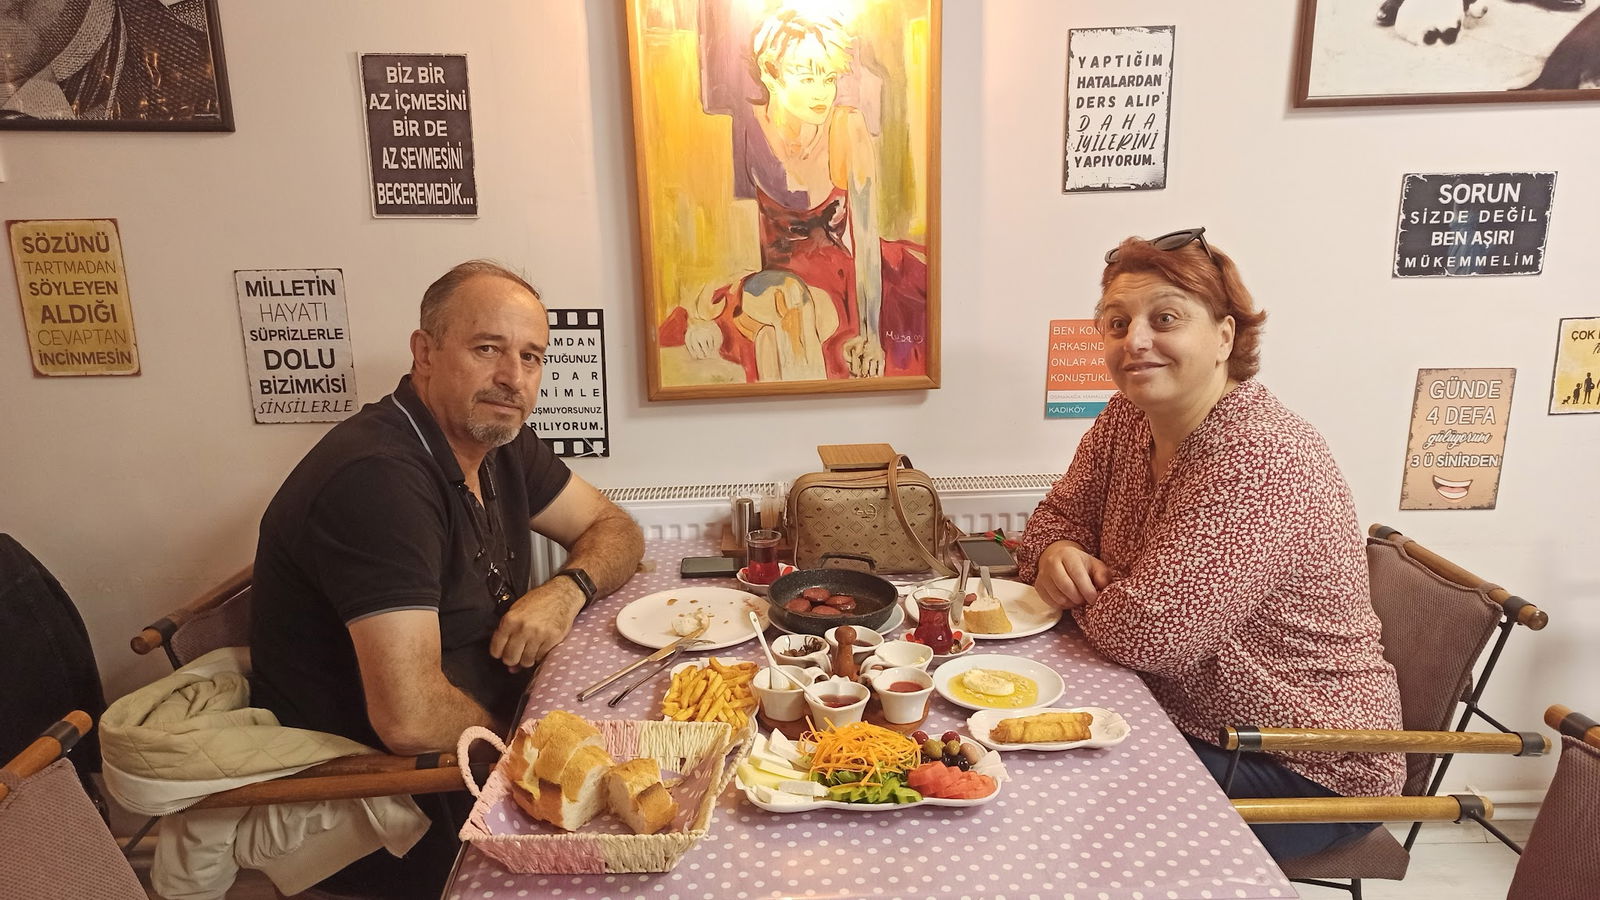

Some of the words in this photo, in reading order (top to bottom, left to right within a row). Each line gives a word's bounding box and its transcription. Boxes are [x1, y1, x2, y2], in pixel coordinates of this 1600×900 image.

[1078, 51, 1163, 68] YAPTIĞIM
[386, 62, 414, 84] BİZ
[418, 62, 445, 84] BİR
[1077, 74, 1162, 89] HATALARDAN
[369, 93, 392, 110] AZ
[395, 89, 467, 114] İÇMESİNİ
[1076, 96, 1116, 109] DERS
[1125, 94, 1161, 107] ALIP
[392, 116, 420, 137] BİR
[424, 120, 448, 137] DE
[1076, 113, 1156, 132] DAHA
[1075, 129, 1159, 153] İYİLERİNİ
[382, 147, 399, 169] AZ
[401, 141, 463, 170] SEVMESİNİ
[1074, 154, 1156, 168] YAPIYORUM.
[377, 178, 473, 205] BECEREMEDİK...
[1438, 183, 1521, 204] SORUN
[1410, 208, 1469, 224] SİZDE
[1479, 206, 1537, 223] DEĞİL
[22, 232, 110, 254] SÖZÜNÜ
[1431, 231, 1467, 246] BEN
[1471, 230, 1514, 248] AŞIRI
[23, 260, 117, 275] TARTMADAN
[1404, 252, 1534, 268] MÜKEMMELİM
[29, 279, 119, 296] SÖYLEYEN
[245, 275, 336, 297] MİLLETİN
[41, 300, 118, 324] ALDIĞI
[259, 302, 328, 322] HAYATI
[37, 329, 127, 346] CEVAPTAN
[250, 326, 344, 341] SÜPRİZLERLE
[1053, 326, 1075, 335] BEN
[1079, 326, 1101, 335] KON
[1571, 330, 1596, 342] ÇOK
[1052, 342, 1105, 351] ARKASIND
[38, 348, 132, 366] İNCİNMESİN
[264, 348, 335, 370] DOLU
[543, 353, 598, 365] ŞTUĞUNUZ
[1051, 358, 1086, 367] ONLAR
[259, 373, 347, 395] BİZİMKİSİ
[552, 371, 598, 381] DAR
[541, 386, 600, 398] NİMLE
[1429, 376, 1502, 399] GÜNDE
[258, 398, 353, 414] SİNSİLERLE
[532, 406, 602, 415] UŞMUYORSUNUZ
[1048, 406, 1086, 414] KADIKÖY
[1426, 406, 1439, 425] 4
[1445, 406, 1496, 425] DEFA
[530, 421, 604, 431] RILIYORUM.
[1422, 429, 1493, 450] gülüyorum
[1411, 455, 1420, 467] 3
[1423, 452, 1434, 467] Ü
[1436, 452, 1500, 467] SİNİRDEN
